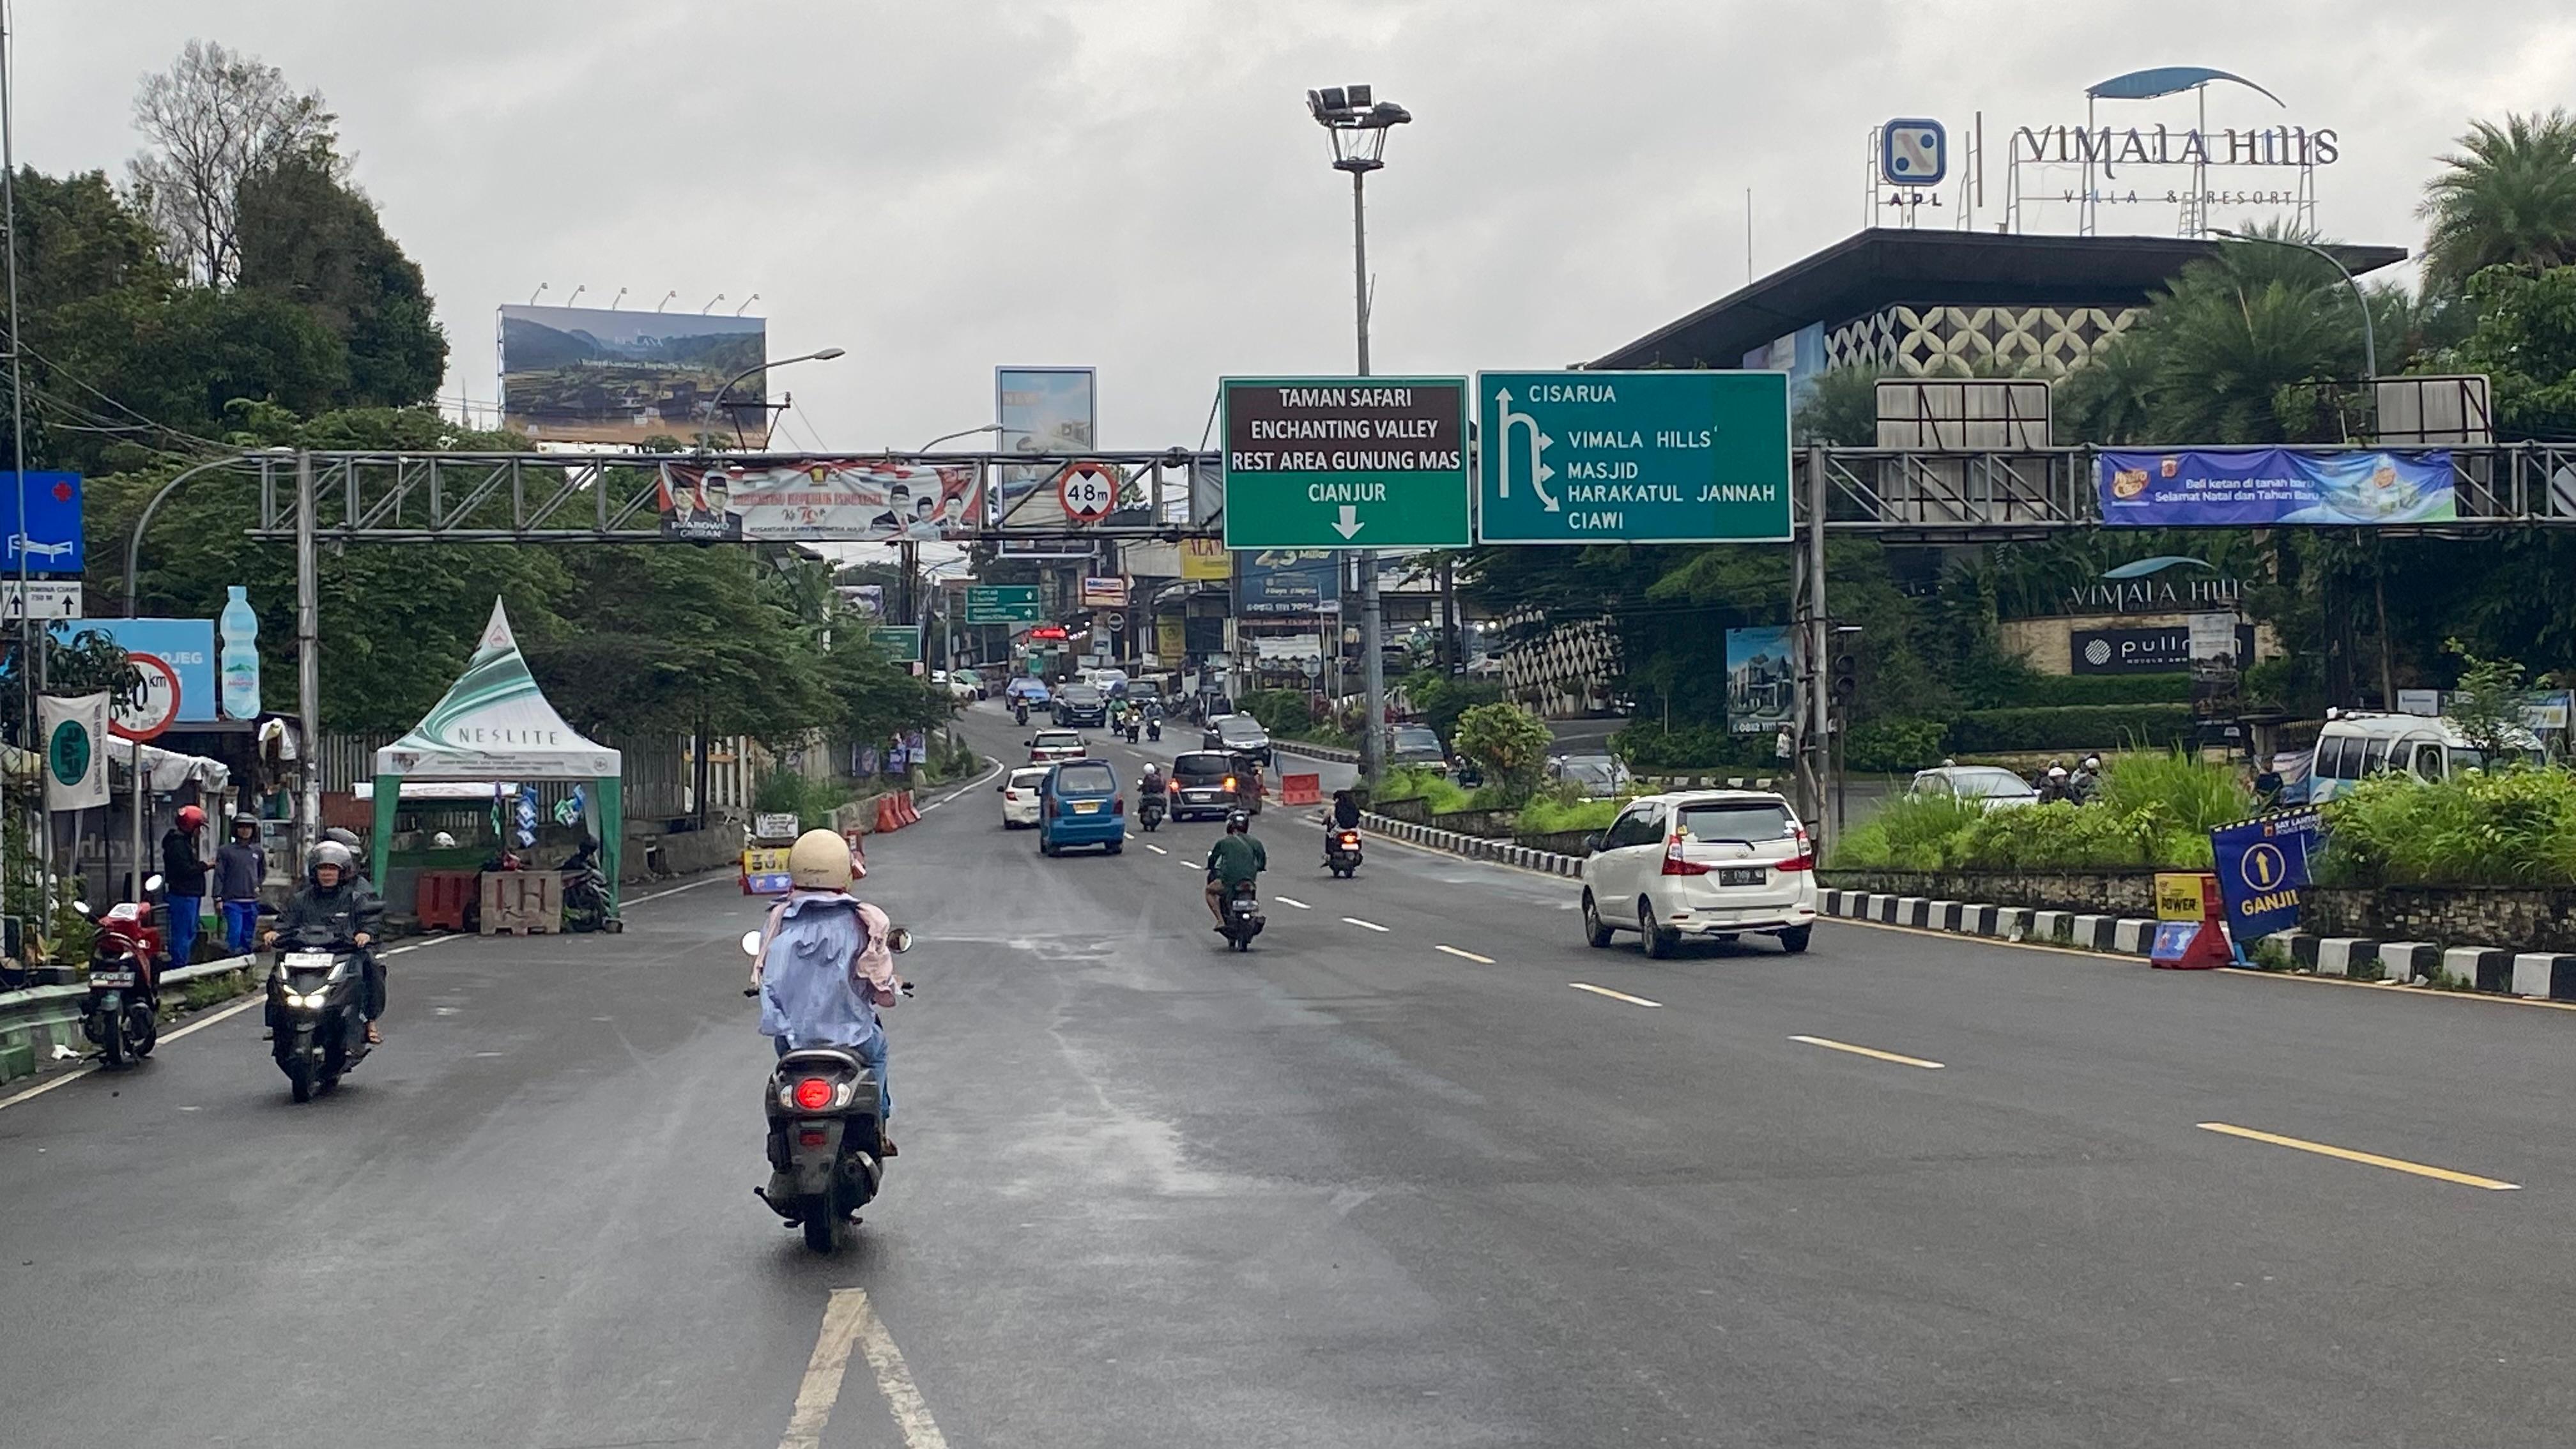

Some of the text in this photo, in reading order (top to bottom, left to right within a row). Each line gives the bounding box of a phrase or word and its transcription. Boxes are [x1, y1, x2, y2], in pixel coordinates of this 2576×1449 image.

[1889, 192, 1942, 207] APL
[2064, 189, 2138, 204] VILLA
[2206, 191, 2292, 205] RESORT
[1278, 388, 1412, 407] TAMAN SAFARI
[1529, 384, 1616, 403] CISARUA
[1250, 420, 1438, 439] ENCHANTING VALLEY
[1568, 431, 1643, 448] VIMALA
[1232, 451, 1460, 470] REST AREA GUNUNG MAS
[1568, 462, 1638, 480] MASJID
[1308, 483, 1386, 502] CIANJUR
[2209, 479, 2241, 489] ketan
[2242, 478, 2253, 489] di
[2255, 479, 2287, 488] tanah
[1568, 484, 1775, 502] HARAKATUL JANNAH
[2155, 491, 2200, 502] Selamat
[2202, 490, 2232, 502] Natal
[2234, 491, 2255, 501] dan
[2257, 490, 2292, 500] Tahun
[2294, 490, 2320, 500] Baru
[1568, 512, 1624, 530] CIAWI
[149, 673, 167, 687] km
[459, 728, 558, 746] NESLITE
[2241, 889, 2300, 916] GANJIL
